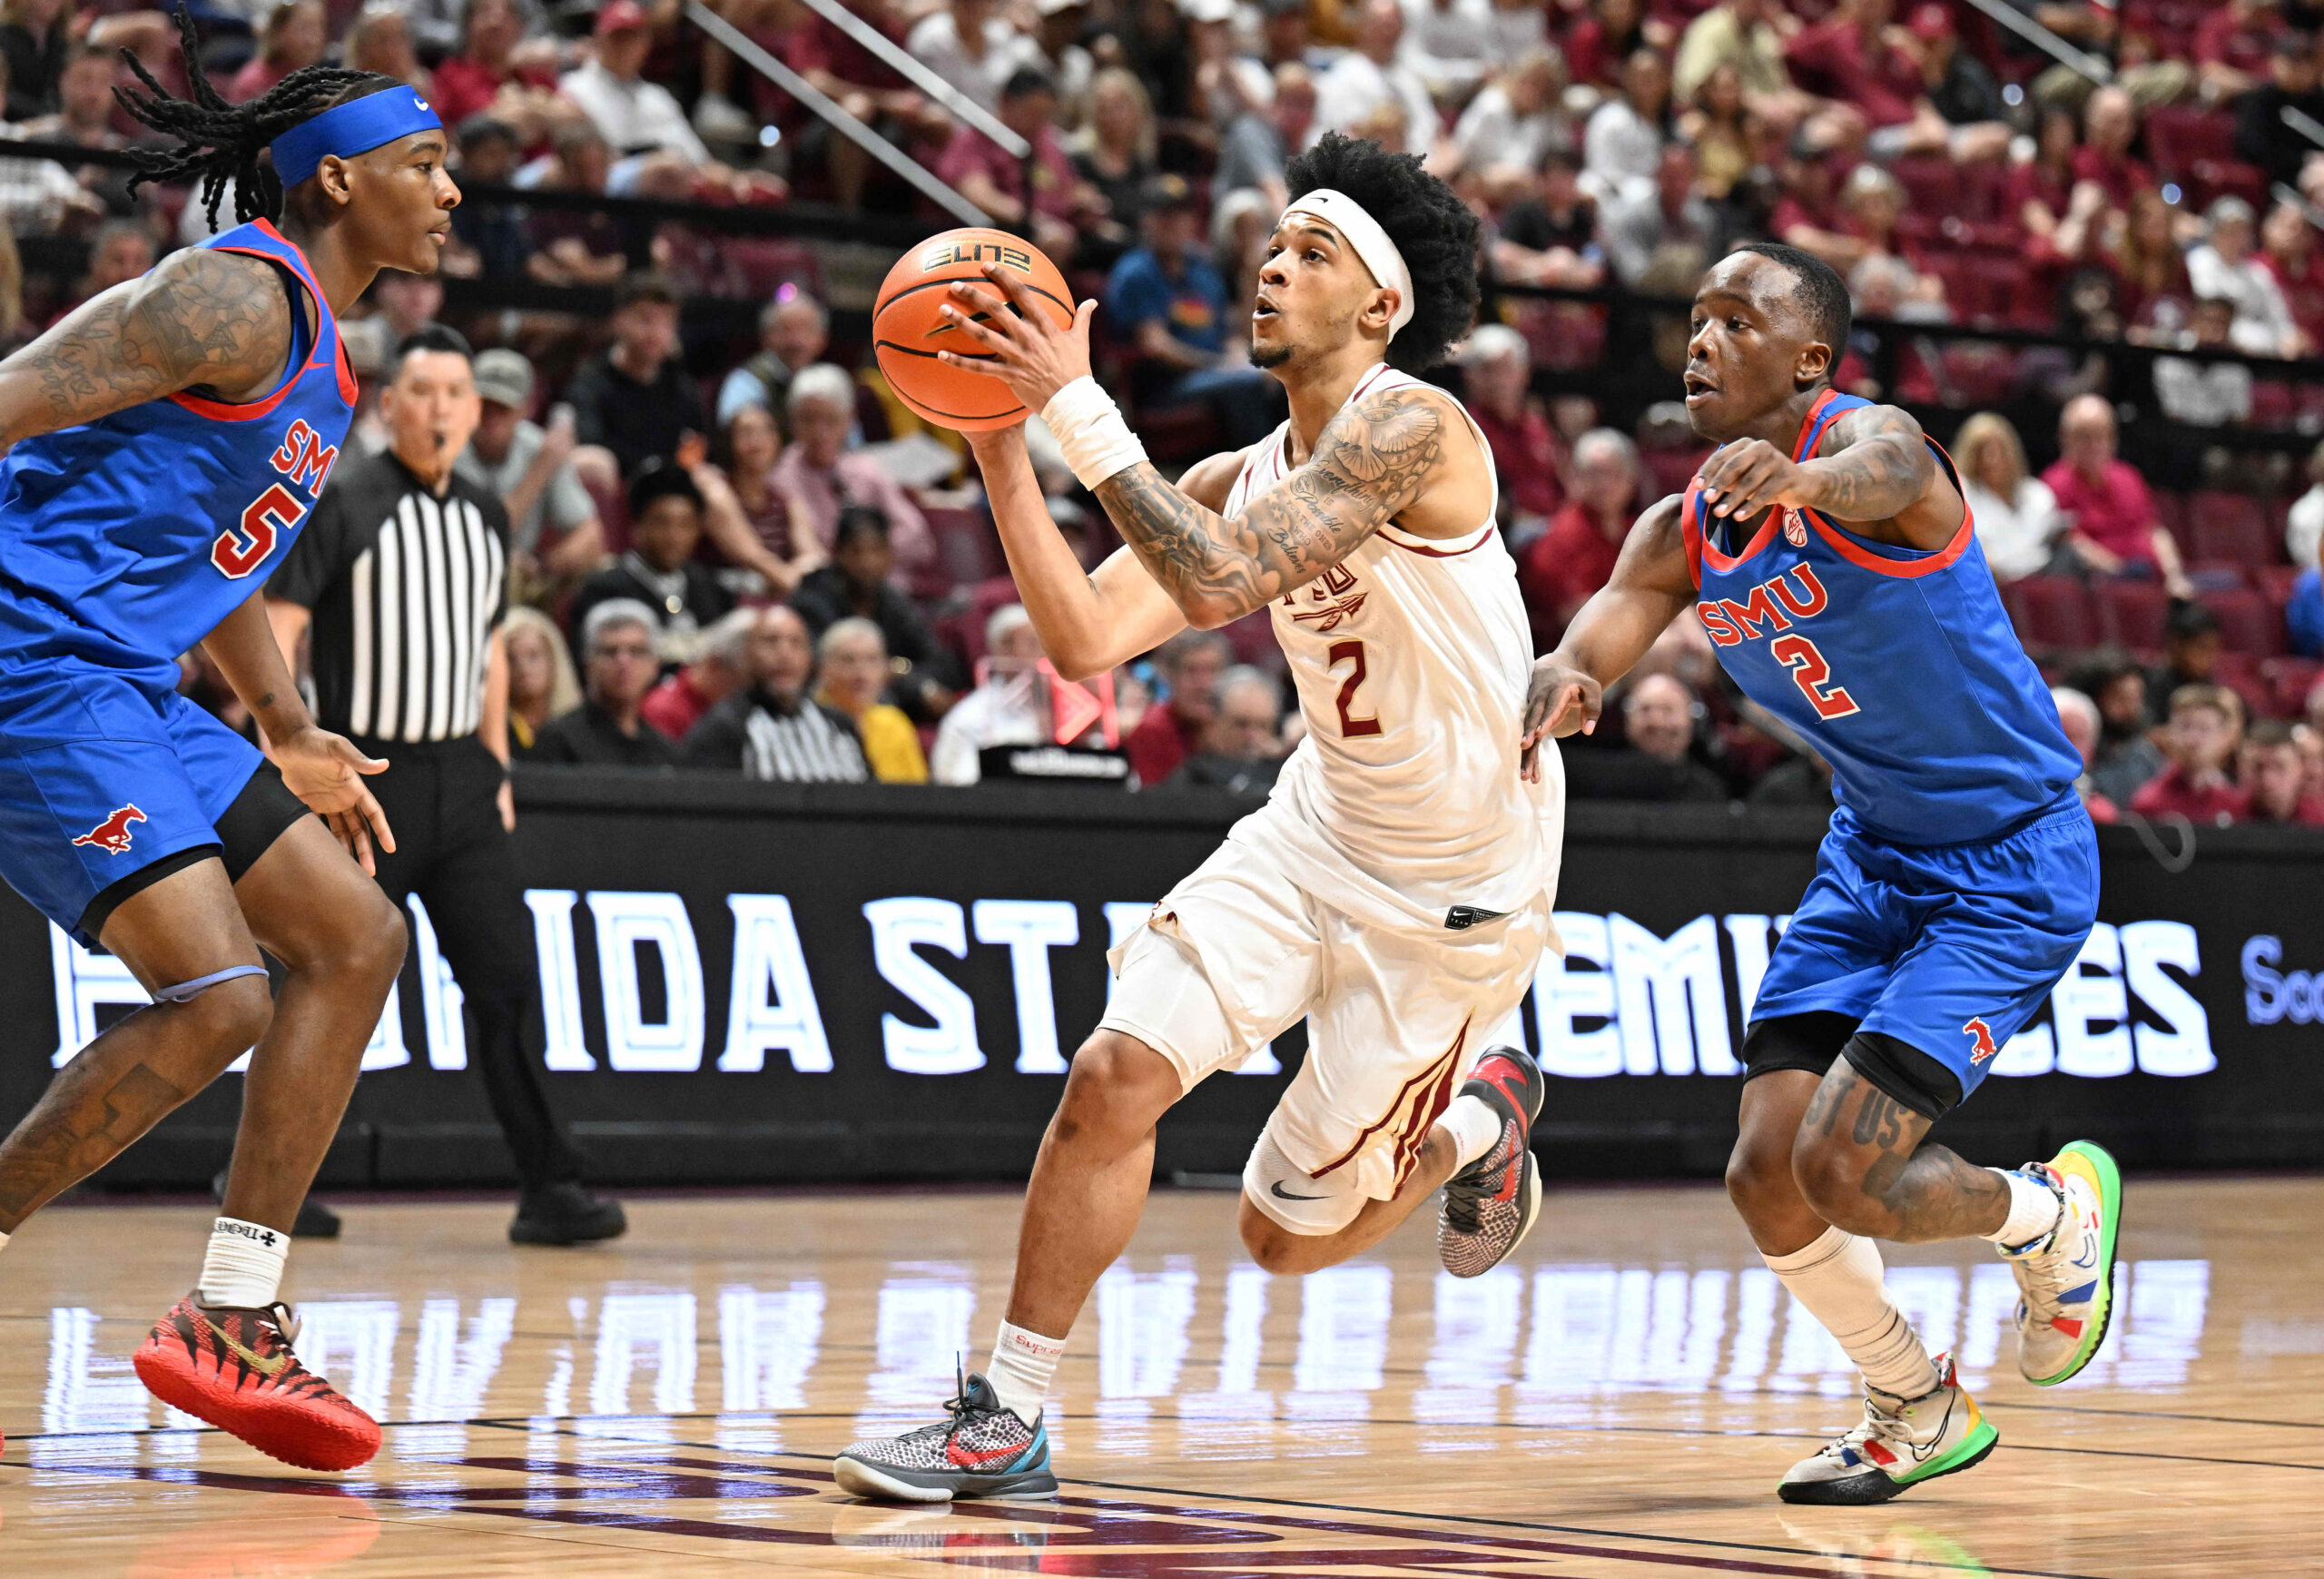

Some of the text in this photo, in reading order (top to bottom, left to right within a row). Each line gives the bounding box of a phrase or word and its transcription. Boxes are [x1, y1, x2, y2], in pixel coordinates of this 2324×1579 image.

[923, 242, 1031, 273] ELITE
[269, 419, 339, 498] SM
[211, 482, 308, 579] 5
[1788, 512, 1800, 534] ACC
[1697, 561, 1827, 647] SMU
[1326, 637, 1384, 740] 2
[1771, 634, 1861, 720] 2
[1854, 1089, 1909, 1149] US
